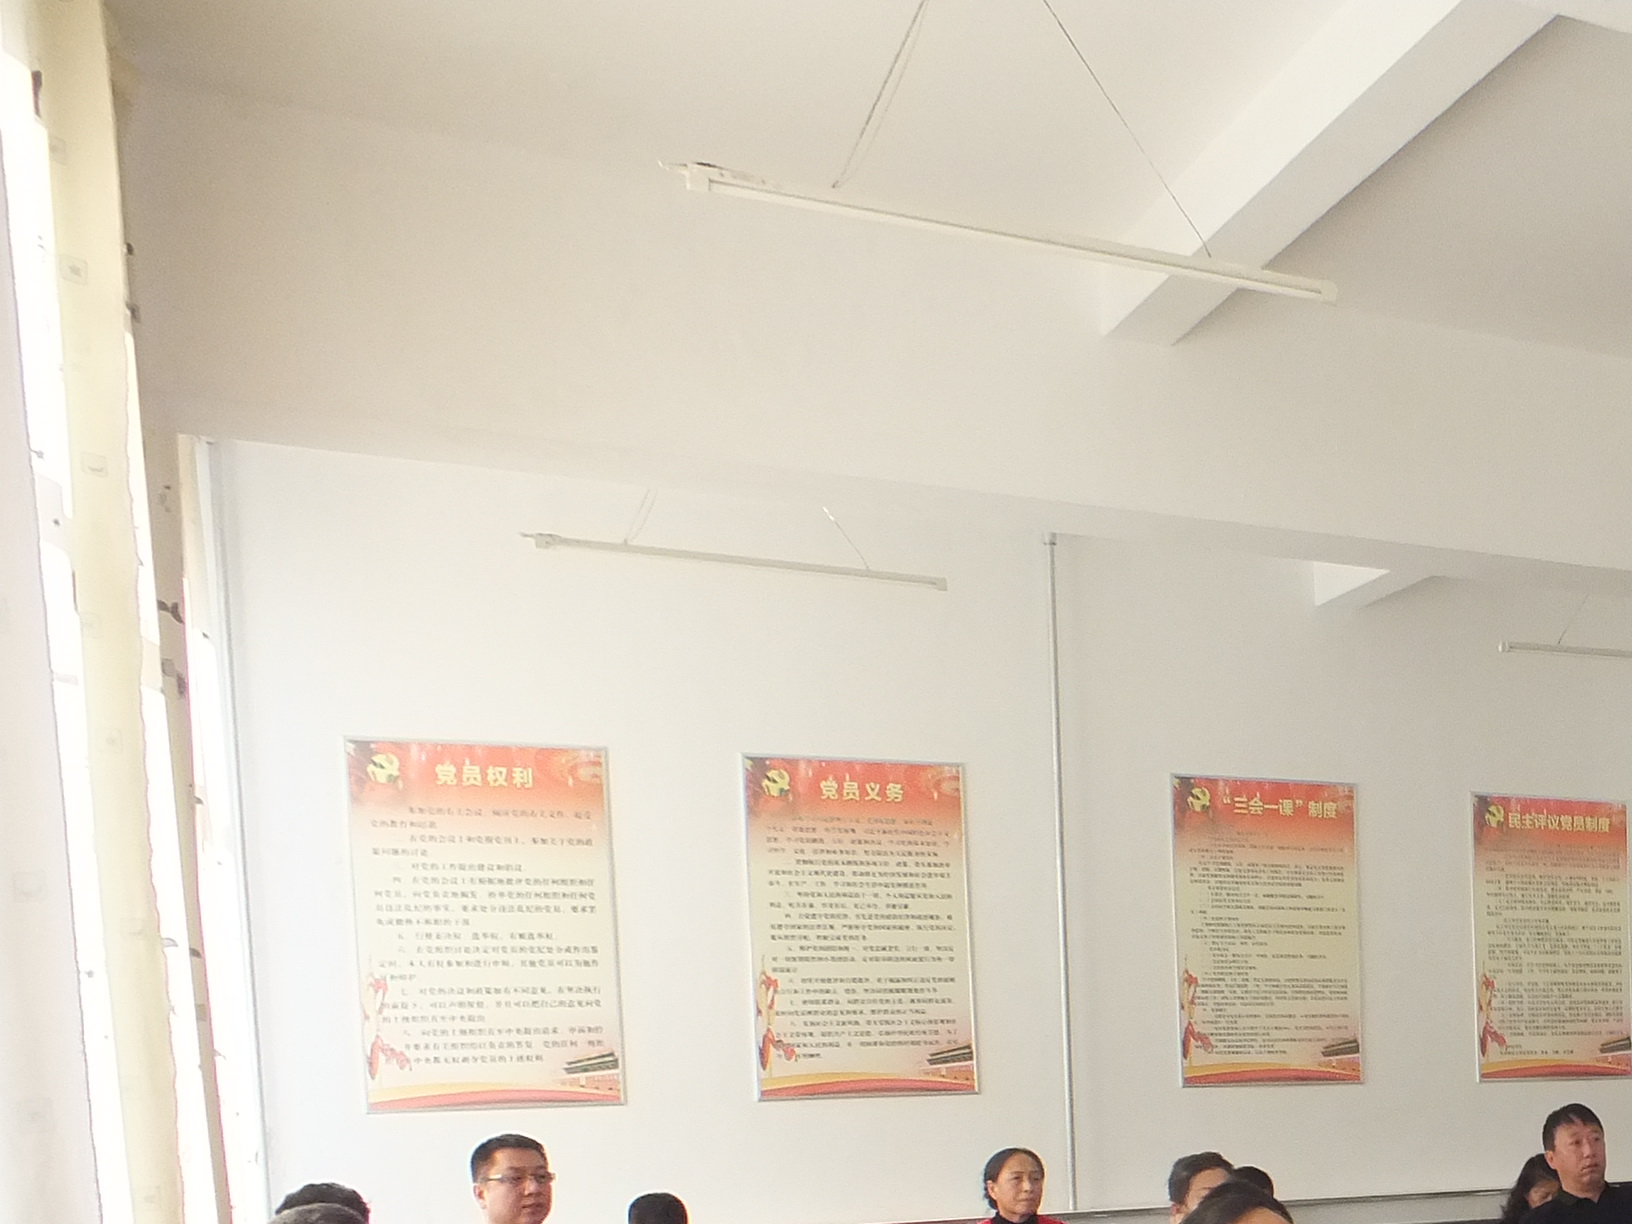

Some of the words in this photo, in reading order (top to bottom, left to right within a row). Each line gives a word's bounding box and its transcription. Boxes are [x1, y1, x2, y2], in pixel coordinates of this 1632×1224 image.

[434, 763, 534, 789] 党员权利
[819, 779, 905, 803] 党员义务
[1507, 811, 1612, 834] 民主评议党员制度
